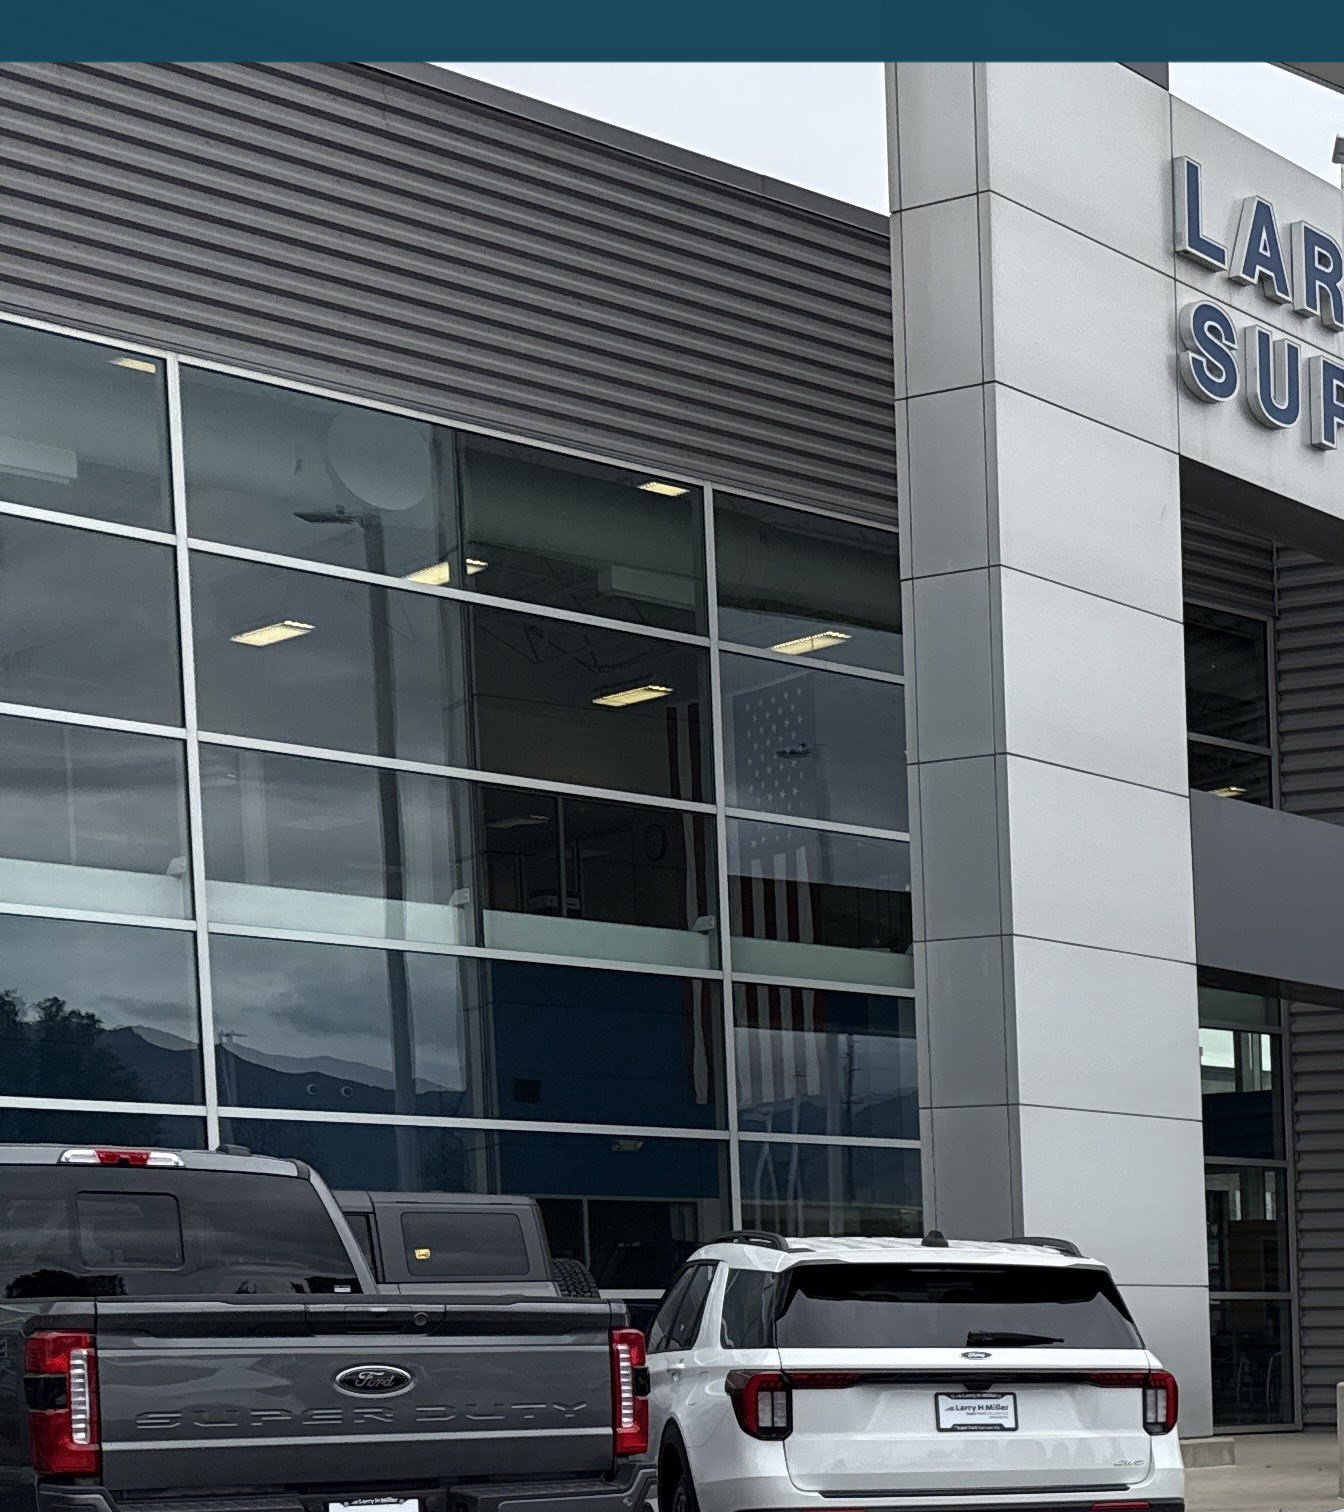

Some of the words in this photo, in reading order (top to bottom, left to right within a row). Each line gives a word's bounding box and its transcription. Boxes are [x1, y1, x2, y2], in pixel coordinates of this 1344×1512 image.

[355, 1370, 396, 1389] Ford
[136, 1406, 394, 1430] SUPER
[415, 1402, 588, 1423] DUTY
